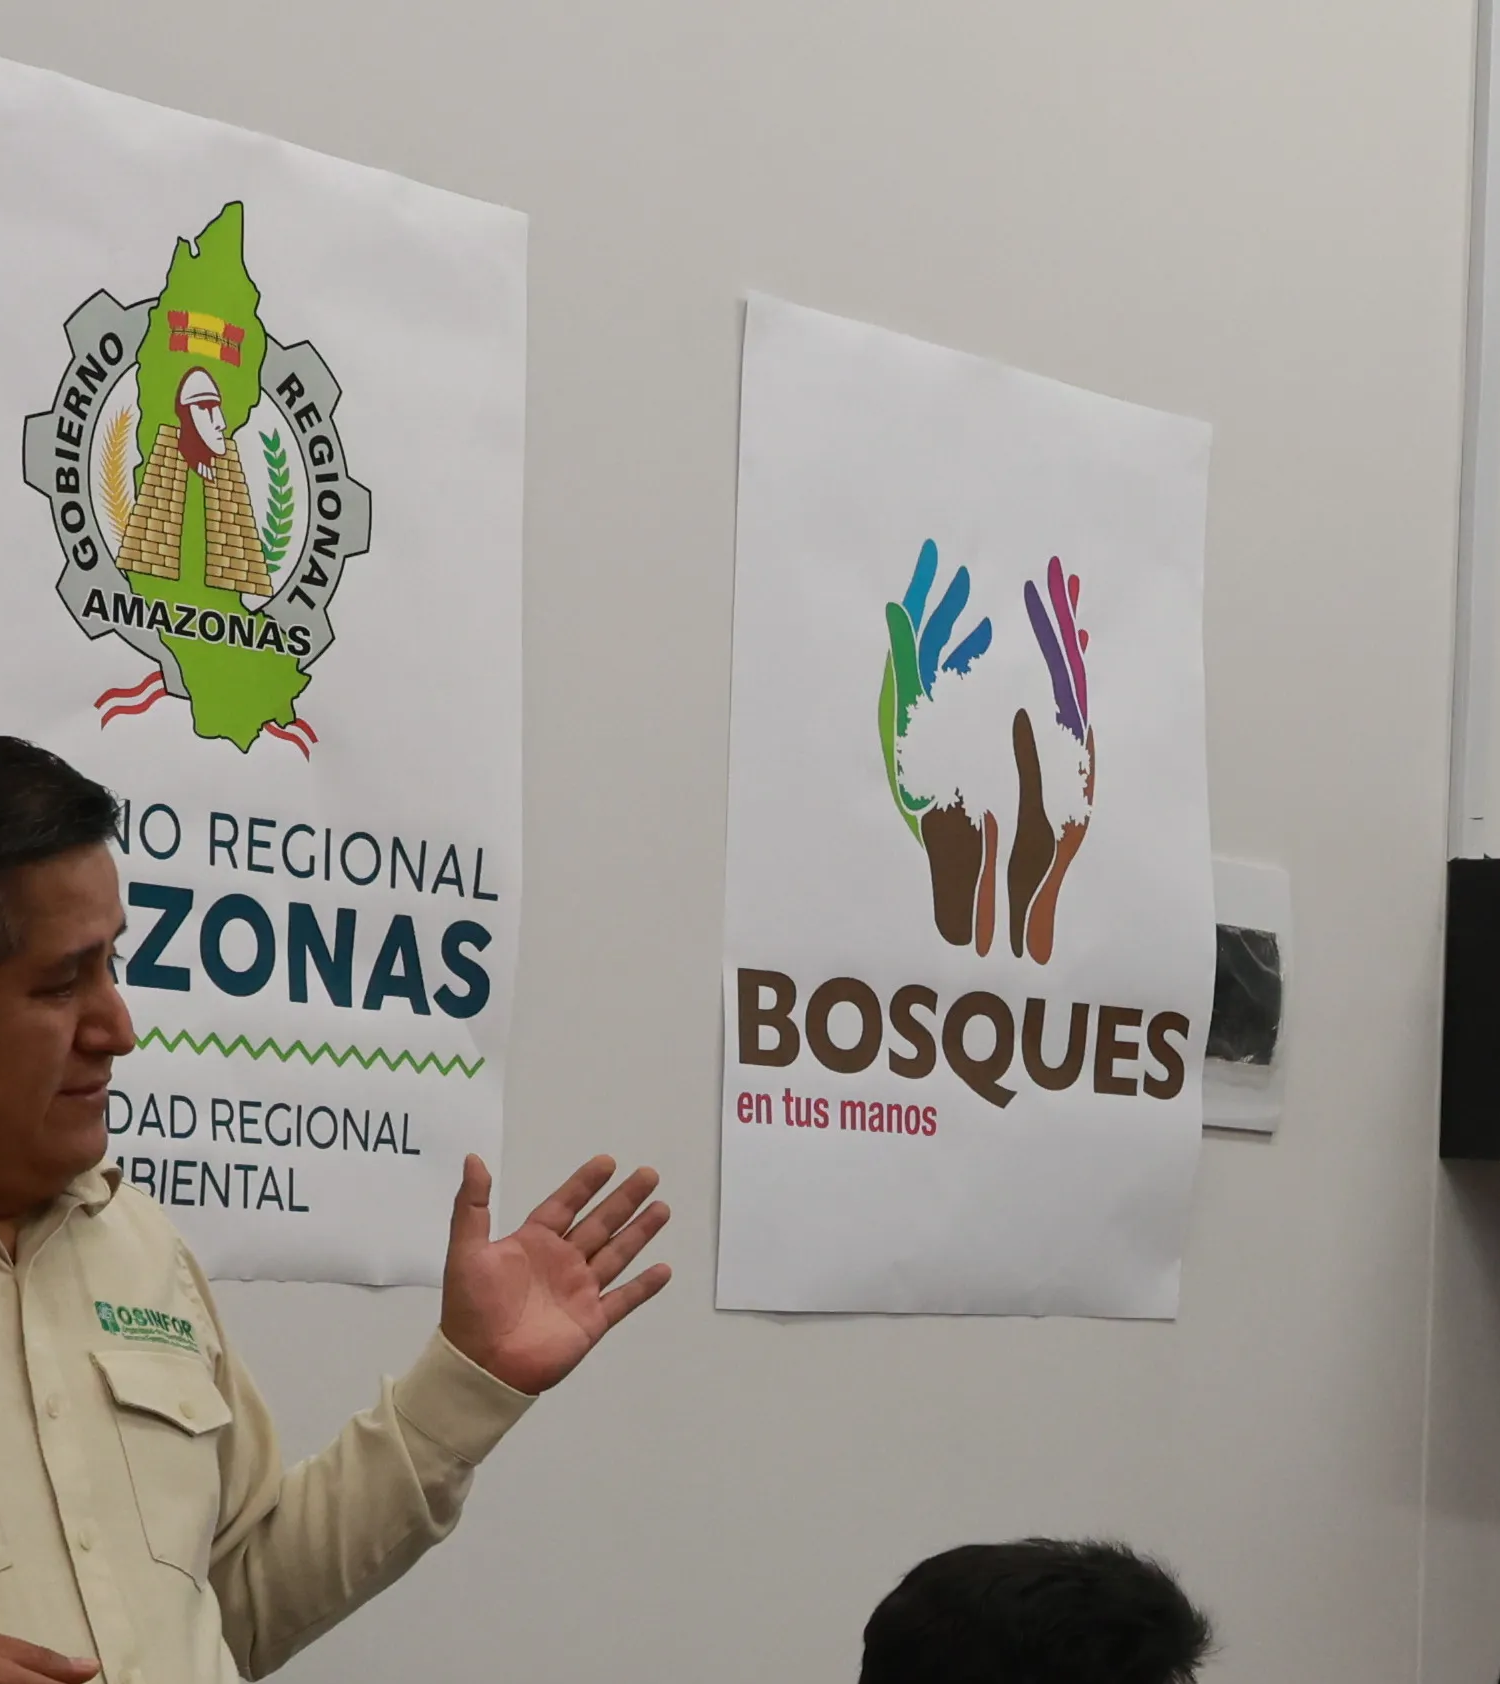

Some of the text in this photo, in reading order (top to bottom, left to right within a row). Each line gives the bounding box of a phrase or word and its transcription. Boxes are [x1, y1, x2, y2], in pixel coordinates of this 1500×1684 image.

[54, 329, 125, 572] GOBIERNO
[275, 371, 343, 611] REGIONAL
[81, 587, 314, 658] AMAZONAS
[208, 811, 499, 902] REGIONAL
[114, 881, 492, 1020] ZONAS
[736, 966, 1190, 1110] BOSQUES
[210, 1097, 422, 1156] REGIONAL
[736, 1088, 938, 1137] en tus manos
[116, 1155, 310, 1213] BIENTAL
[115, 1305, 193, 1339] OSINFOR
